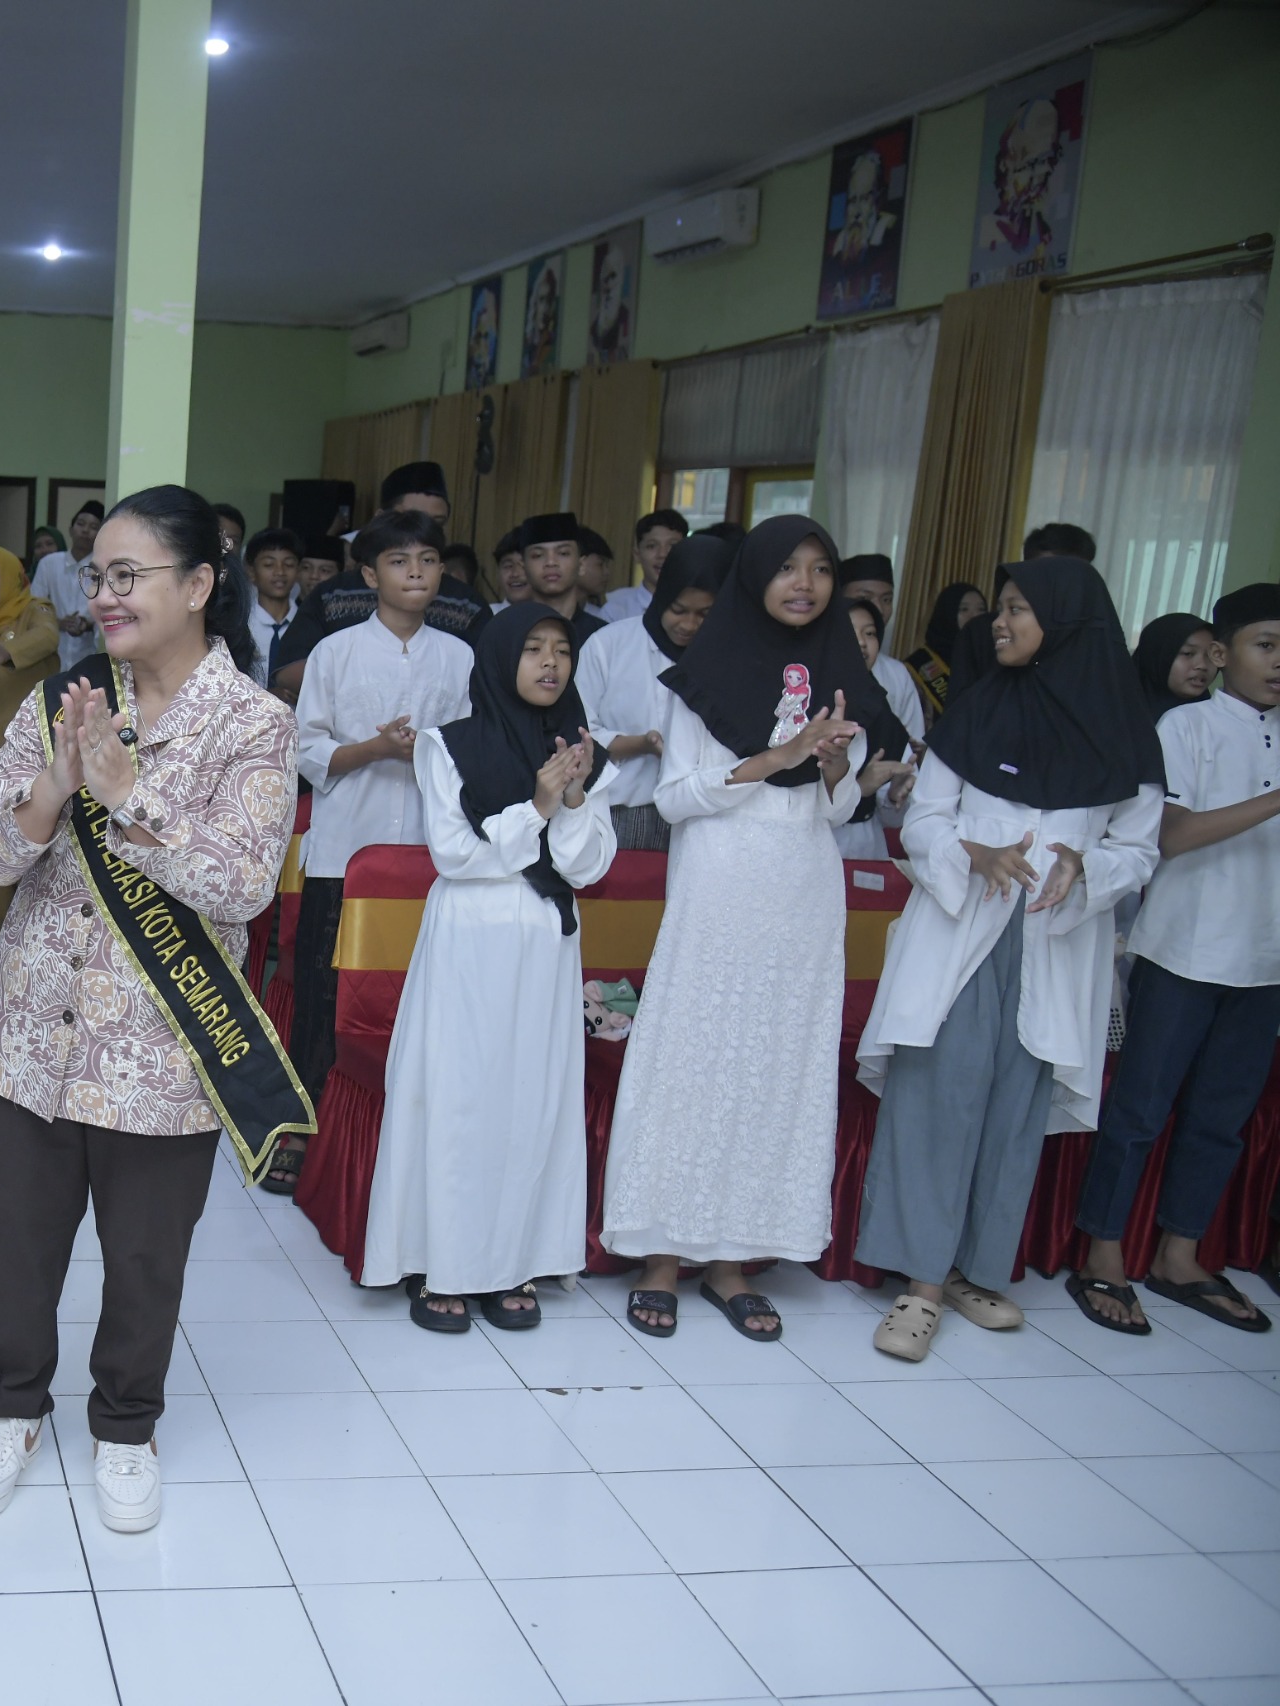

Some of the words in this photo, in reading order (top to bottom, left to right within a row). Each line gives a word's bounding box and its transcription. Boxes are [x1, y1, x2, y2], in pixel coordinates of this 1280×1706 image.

[89, 816, 159, 910] LRASI
[136, 901, 187, 965] KOTA
[170, 955, 251, 1068] SEMARANG
